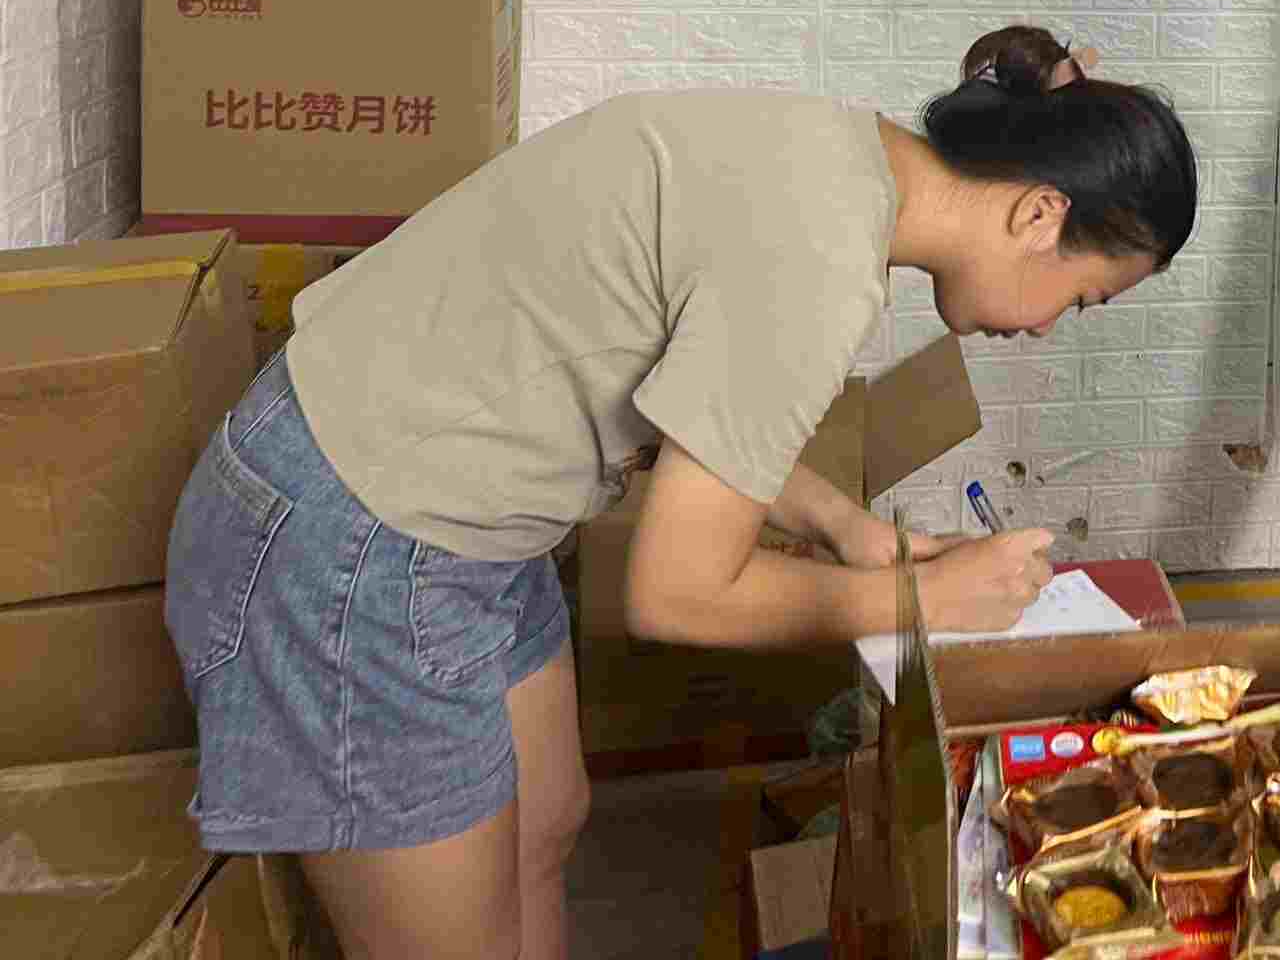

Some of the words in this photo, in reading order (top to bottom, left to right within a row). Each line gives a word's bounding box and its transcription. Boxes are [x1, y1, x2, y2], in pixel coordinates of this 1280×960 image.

[204, 88, 437, 136] 比比赞月饼
